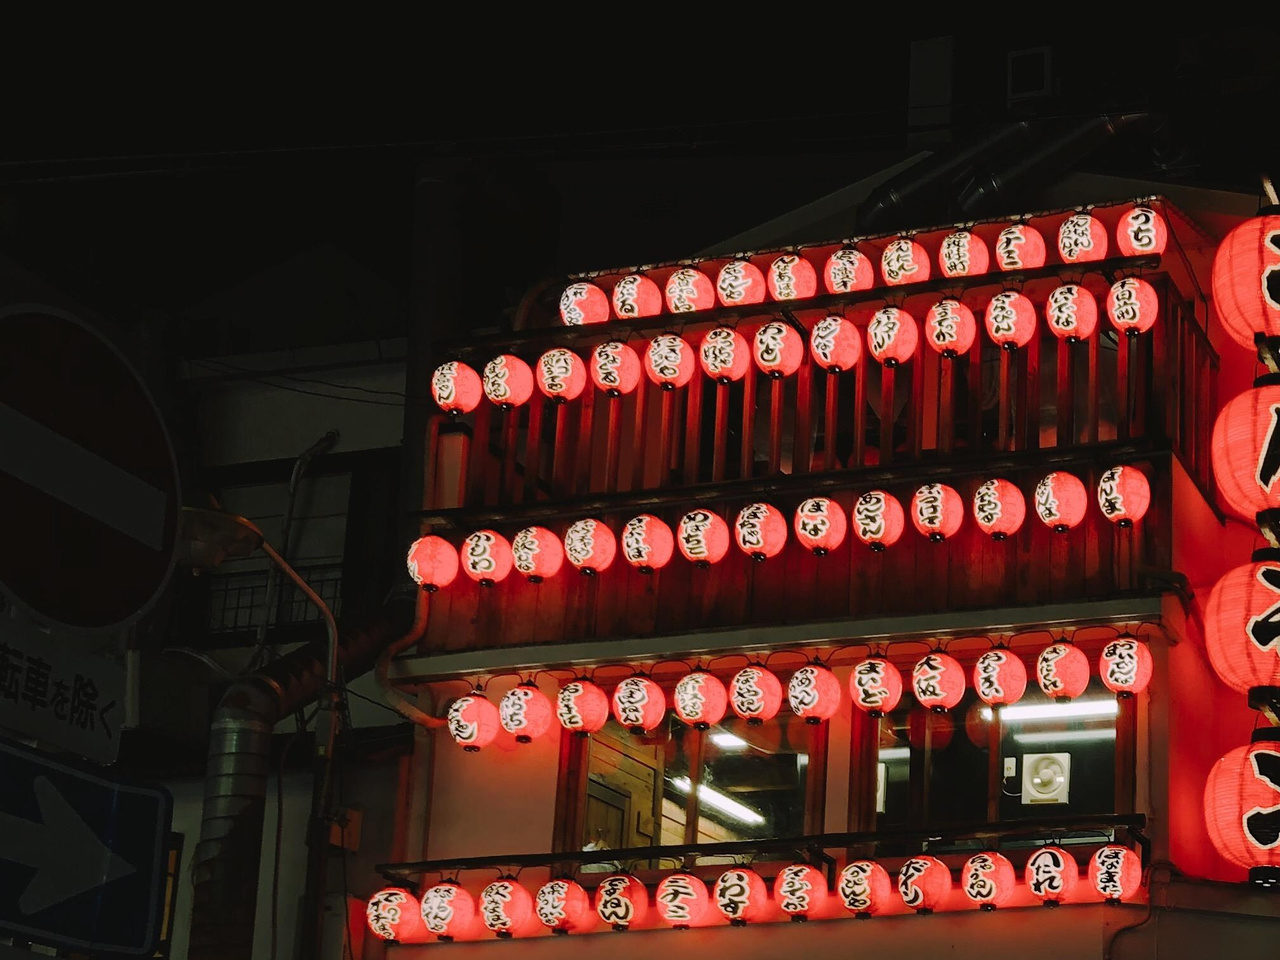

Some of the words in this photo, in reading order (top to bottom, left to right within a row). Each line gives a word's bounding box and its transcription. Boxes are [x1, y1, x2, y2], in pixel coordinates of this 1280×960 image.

[1129, 210, 1155, 249] うち
[1113, 281, 1139, 322] 千日前
[800, 502, 828, 538] ほな
[468, 534, 494, 572] かしわ
[856, 662, 888, 705] まいど
[915, 657, 945, 699] 大阪
[966, 856, 995, 899] ちゃうねん
[1029, 851, 1063, 894] へたれ
[1097, 849, 1125, 896] ほなまた
[659, 878, 695, 919] ミナミ
[718, 873, 748, 916] いわす
